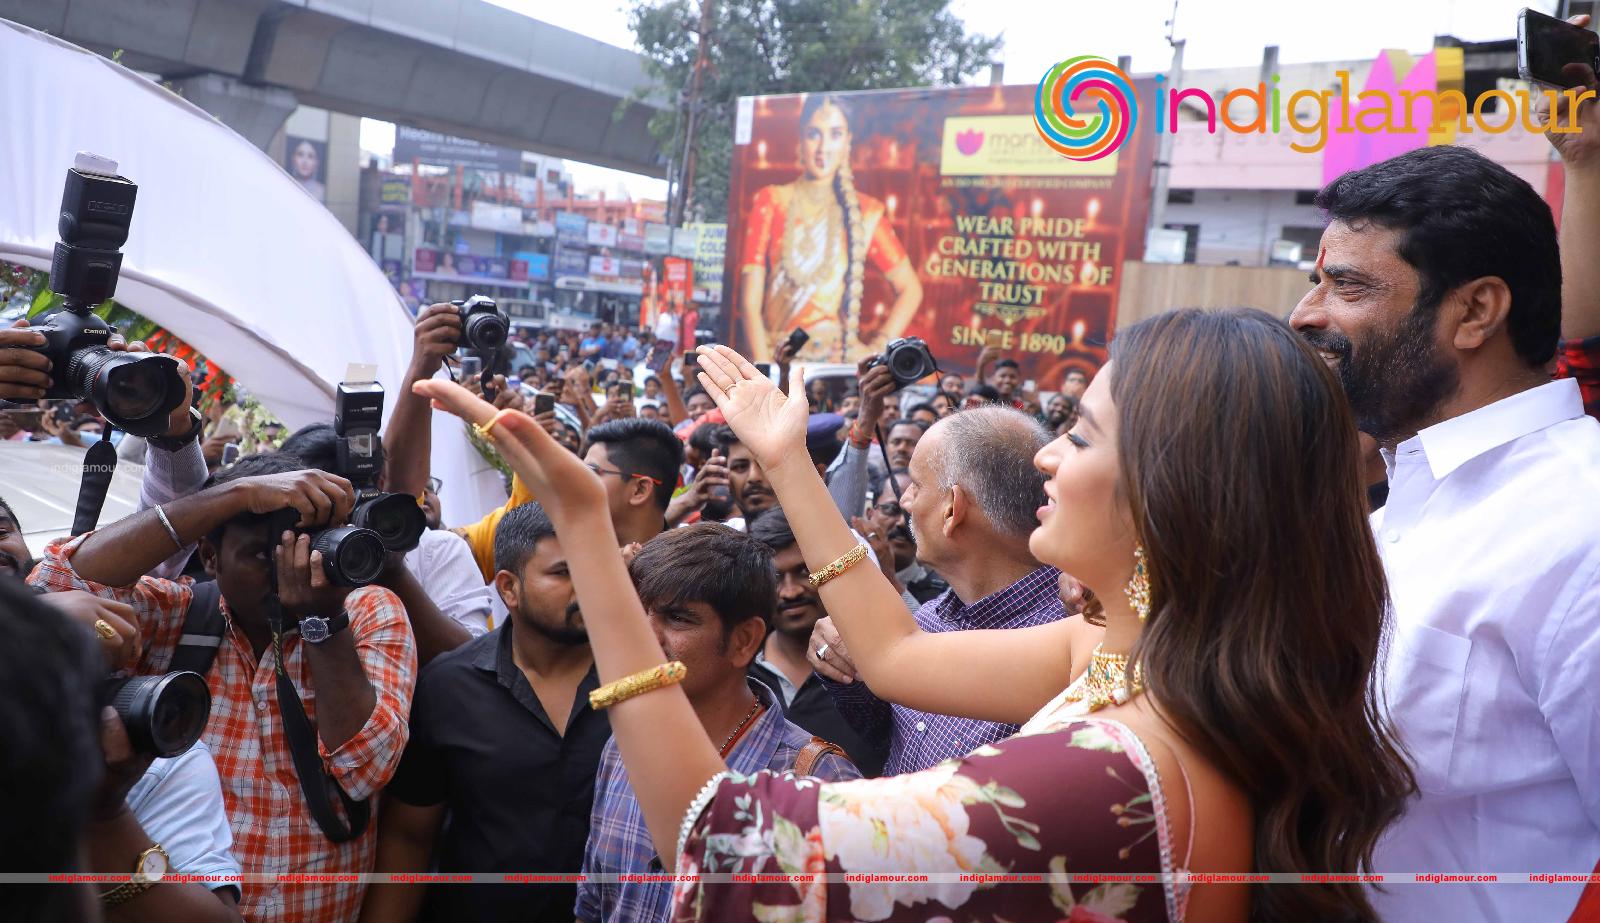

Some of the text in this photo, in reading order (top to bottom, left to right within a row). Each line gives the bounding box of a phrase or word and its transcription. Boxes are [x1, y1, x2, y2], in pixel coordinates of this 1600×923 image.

[956, 215, 1086, 238] WEAR PRIDE
[938, 236, 1102, 262] CRAFTED WITH
[925, 258, 1114, 287] GENERATIONS OF
[979, 281, 1048, 305] TRUST
[84, 328, 107, 336] Canon
[951, 325, 1067, 356] SINE 1890
